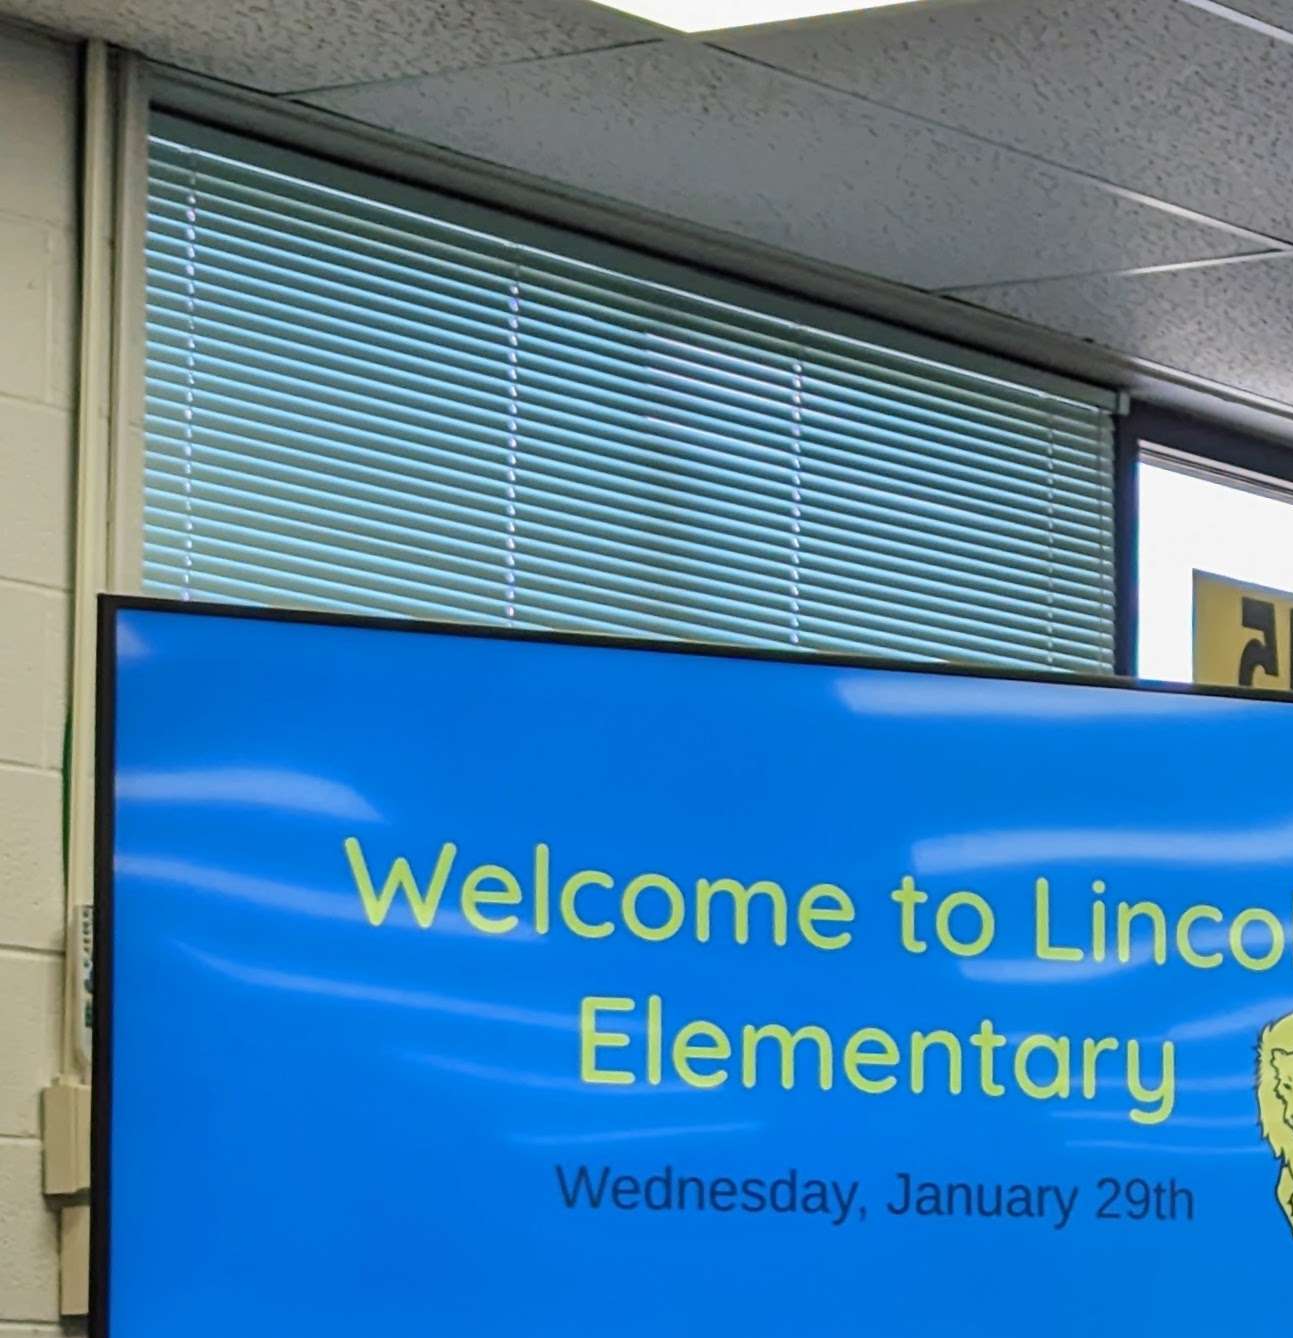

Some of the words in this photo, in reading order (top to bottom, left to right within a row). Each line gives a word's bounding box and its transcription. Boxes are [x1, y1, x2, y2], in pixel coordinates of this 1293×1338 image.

[344, 837, 855, 949] Welcome
[892, 878, 994, 956] to
[580, 996, 1175, 1124] Elementary
[555, 1165, 868, 1226] Wednesday,
[887, 1172, 1079, 1229] January
[1096, 1177, 1194, 1221] 29th
